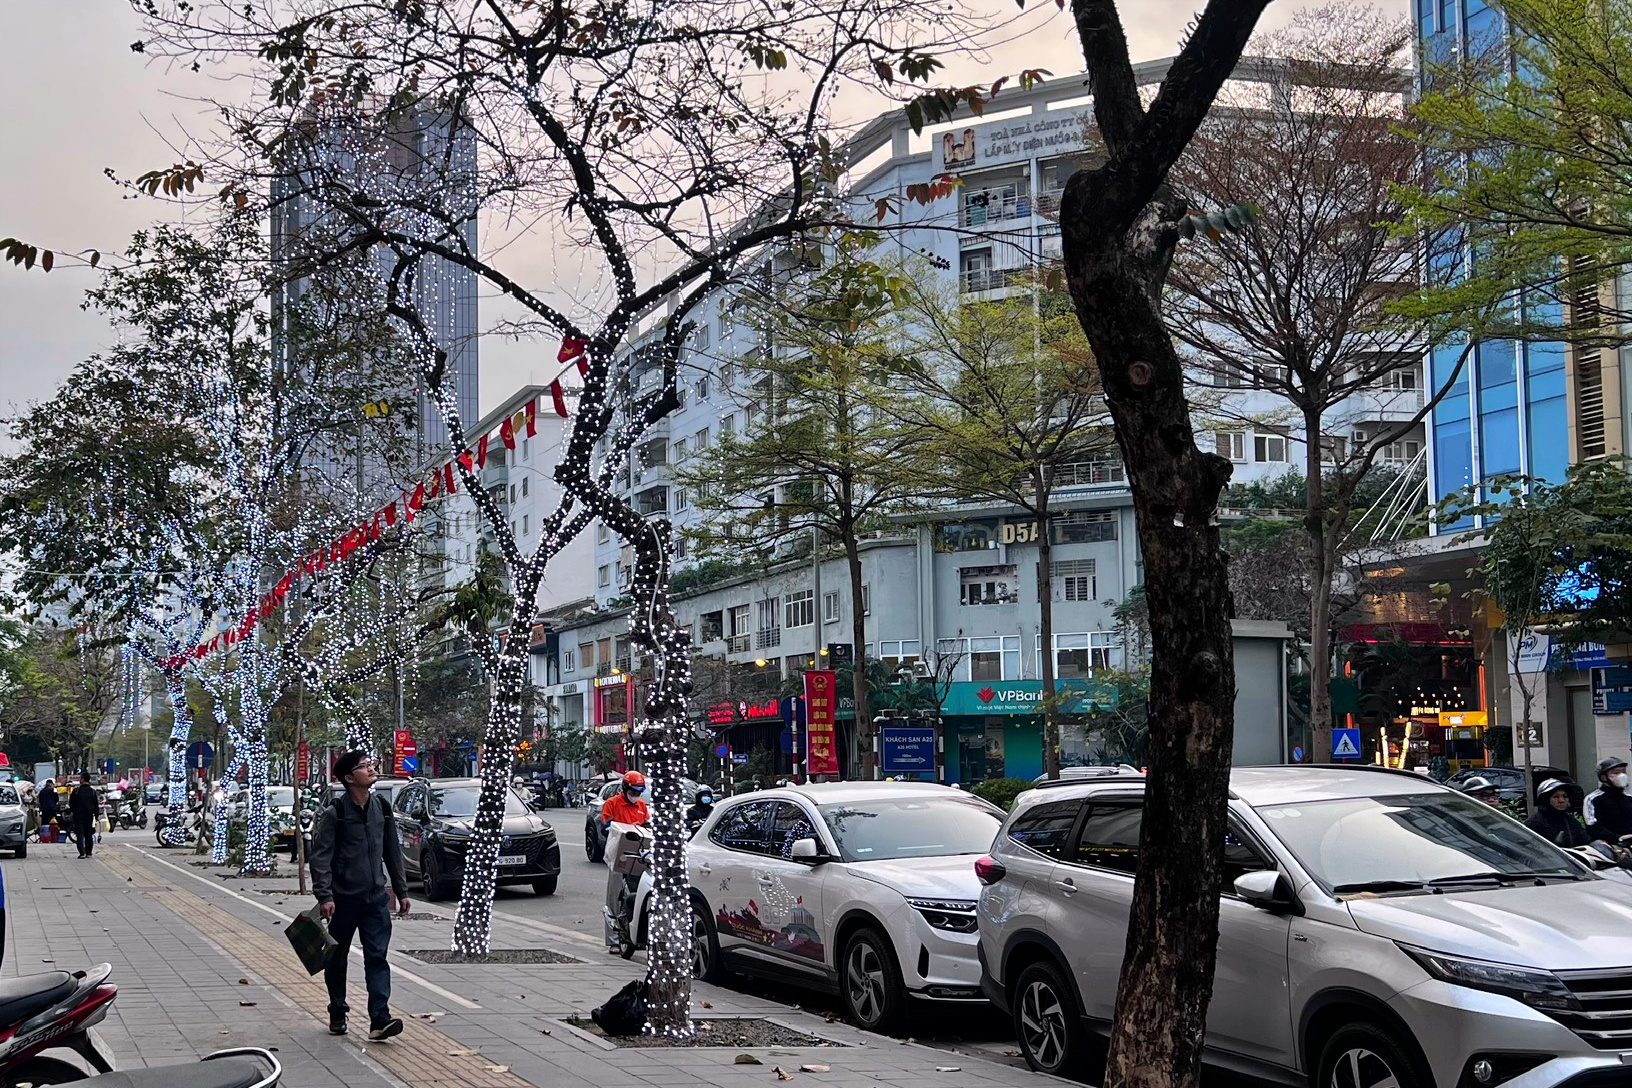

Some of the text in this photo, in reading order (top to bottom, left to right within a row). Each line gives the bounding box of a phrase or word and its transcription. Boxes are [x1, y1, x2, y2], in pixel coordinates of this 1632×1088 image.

[1034, 120, 1059, 132] CÔNG
[1061, 117, 1074, 127] TY
[1002, 522, 1040, 545] D5A
[886, 735, 907, 743] KHÁCH
[908, 736, 921, 744] SẠN
